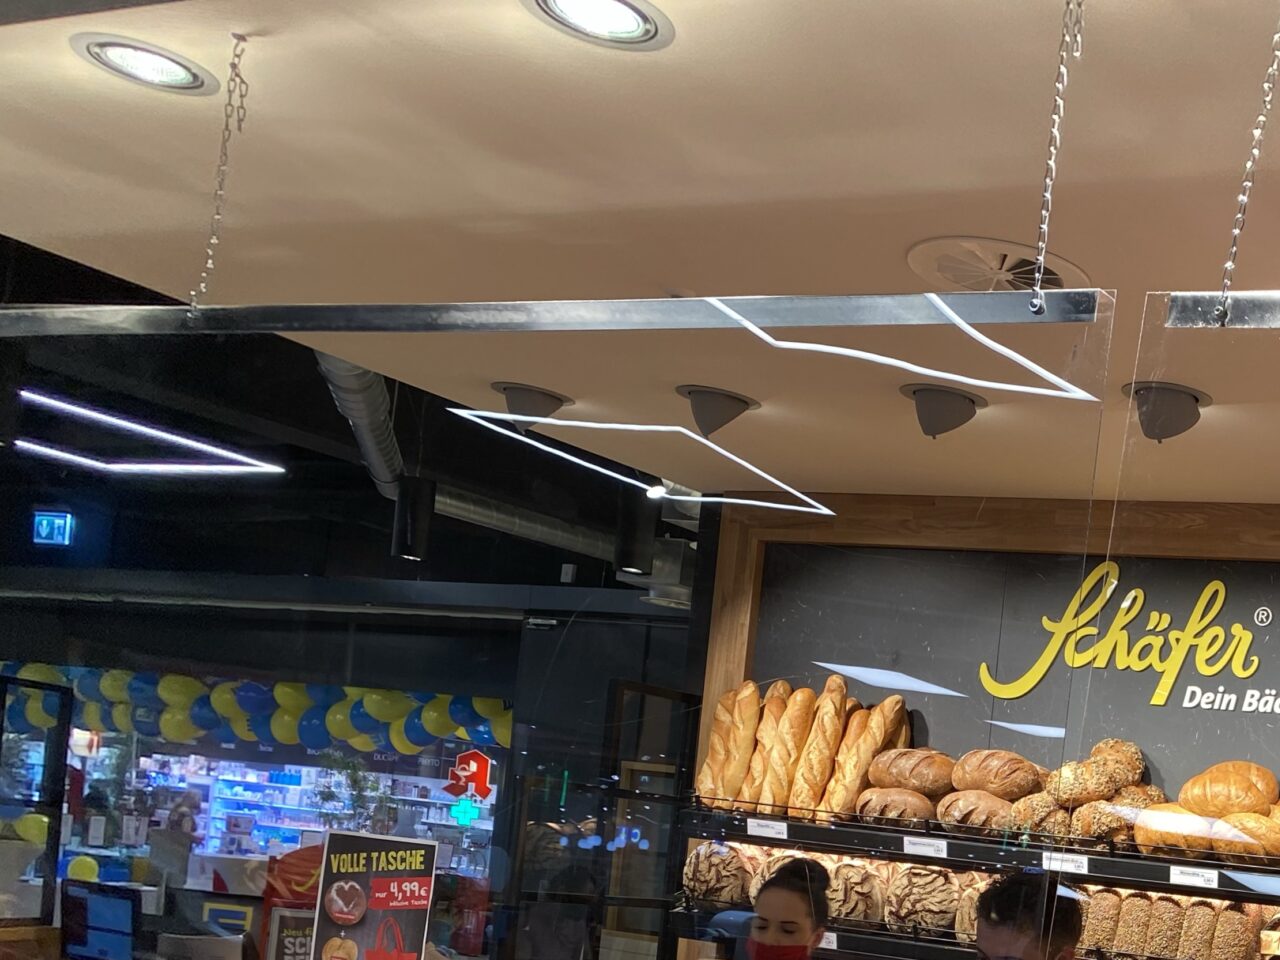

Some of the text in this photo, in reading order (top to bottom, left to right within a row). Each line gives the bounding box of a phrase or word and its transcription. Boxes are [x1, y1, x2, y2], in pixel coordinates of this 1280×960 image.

[979, 560, 1259, 706] Schäfer
[1182, 685, 1237, 712] Dein
[329, 849, 426, 874] VOLLE TASCHE
